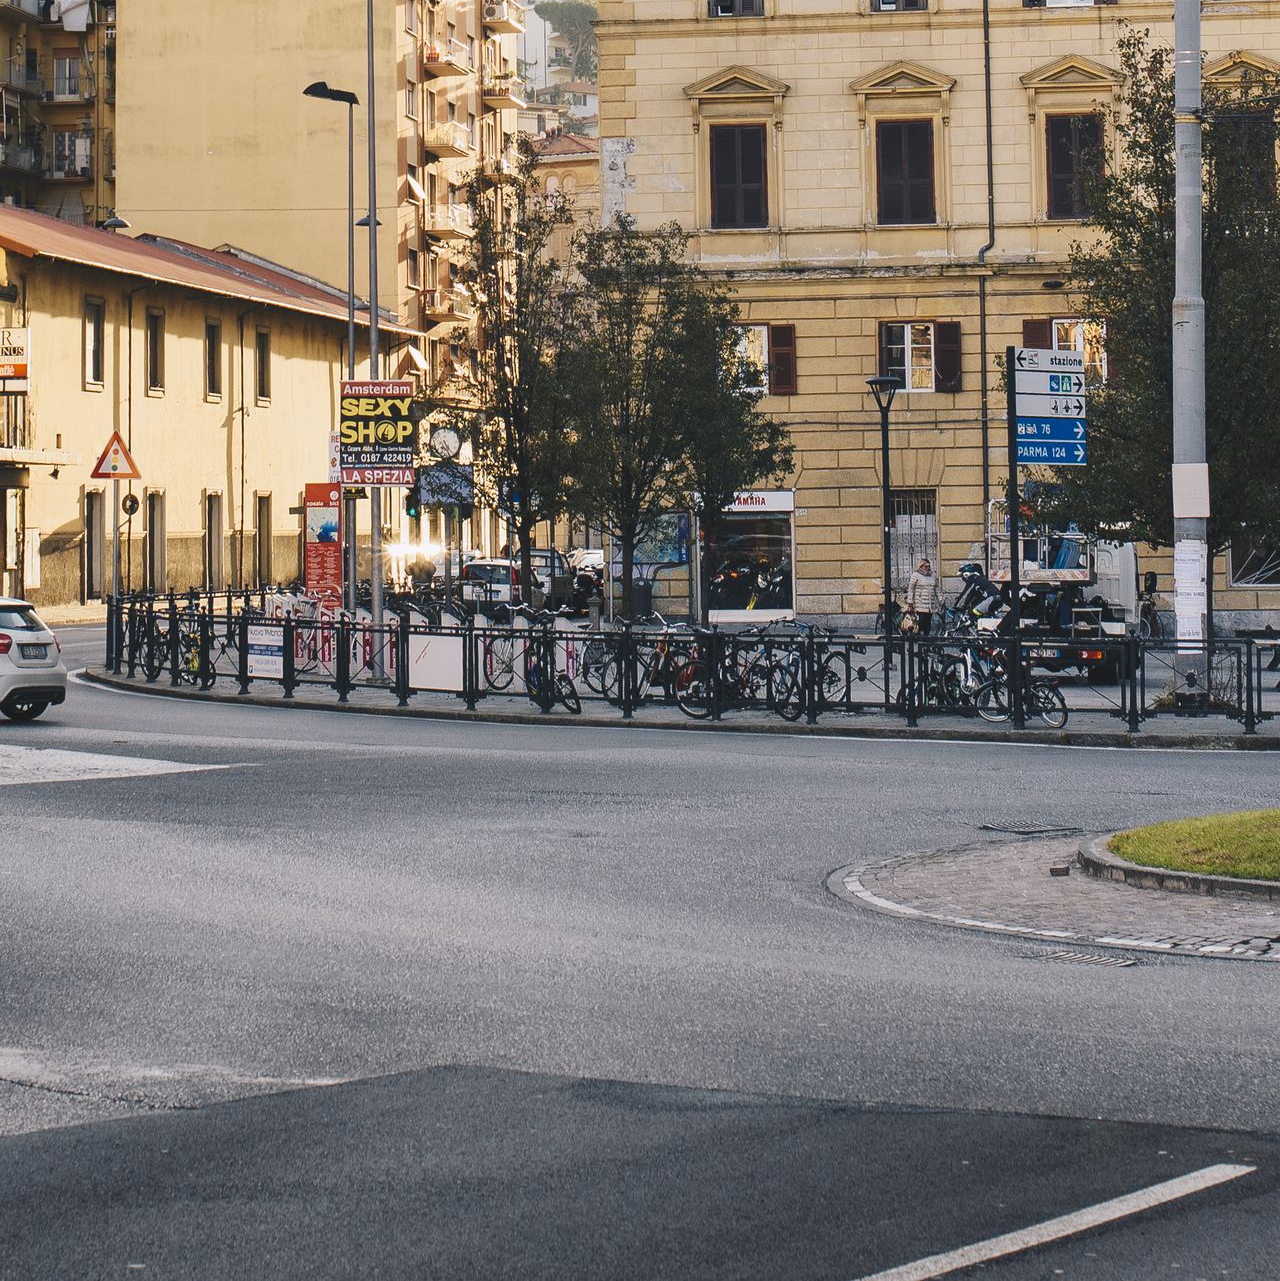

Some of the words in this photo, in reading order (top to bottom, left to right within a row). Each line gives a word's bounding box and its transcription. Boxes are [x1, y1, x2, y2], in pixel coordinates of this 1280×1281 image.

[1049, 355, 1083, 367] stazione
[343, 384, 411, 395] Amsterdam
[341, 398, 412, 417] SEXY
[340, 420, 413, 444] SHOP
[1040, 424, 1051, 435] 76
[342, 453, 359, 463] Tel.
[360, 453, 382, 463] 0187
[383, 453, 412, 463] 422419
[1017, 446, 1049, 458] PARMA
[1051, 447, 1066, 458] 124
[342, 470, 361, 483] LA
[364, 469, 413, 484] SPEZIA
[734, 497, 767, 506] AMAHA
